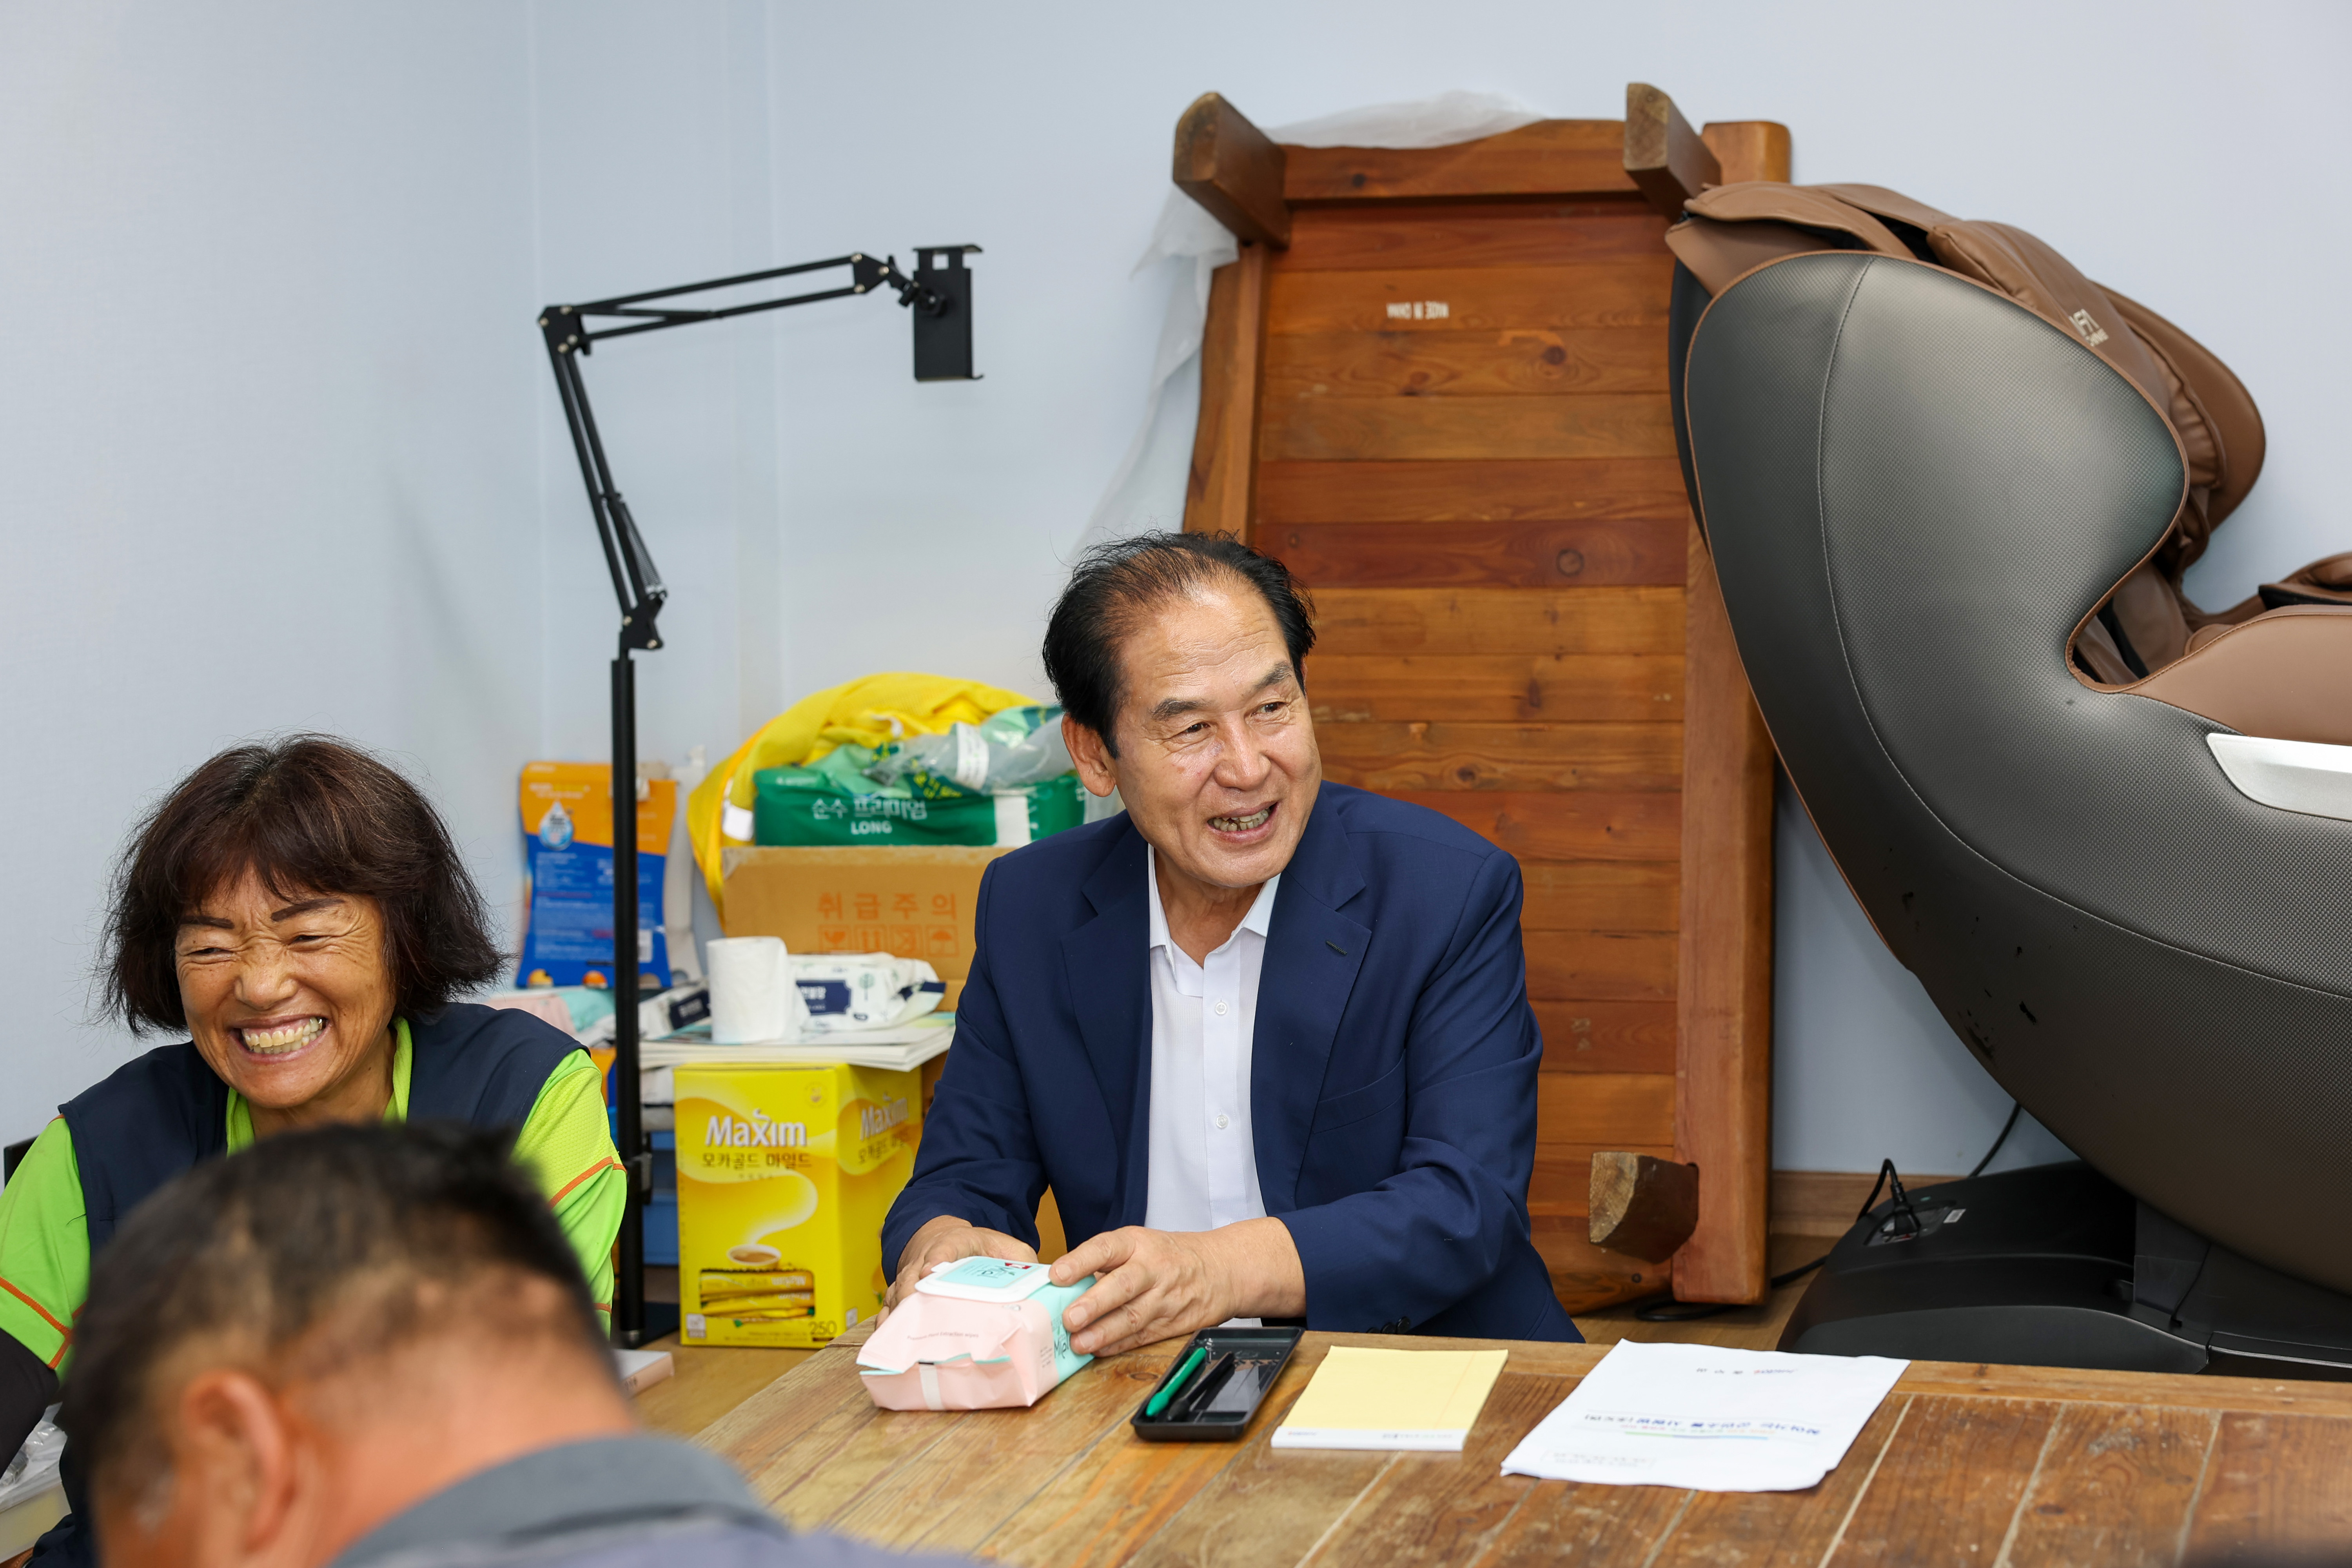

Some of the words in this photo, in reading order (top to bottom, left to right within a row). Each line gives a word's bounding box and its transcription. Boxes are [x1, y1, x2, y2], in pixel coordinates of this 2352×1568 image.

[812, 798, 848, 820] 순수
[854, 799, 927, 820] 프리미엄
[851, 821, 892, 835] LONG
[818, 892, 956, 920] 취급주의
[860, 1092, 909, 1141] Maxim
[705, 1109, 807, 1147] Maxim
[702, 1152, 760, 1170] 모카골드
[765, 1151, 811, 1170] 마일드
[808, 1321, 837, 1336] 250
